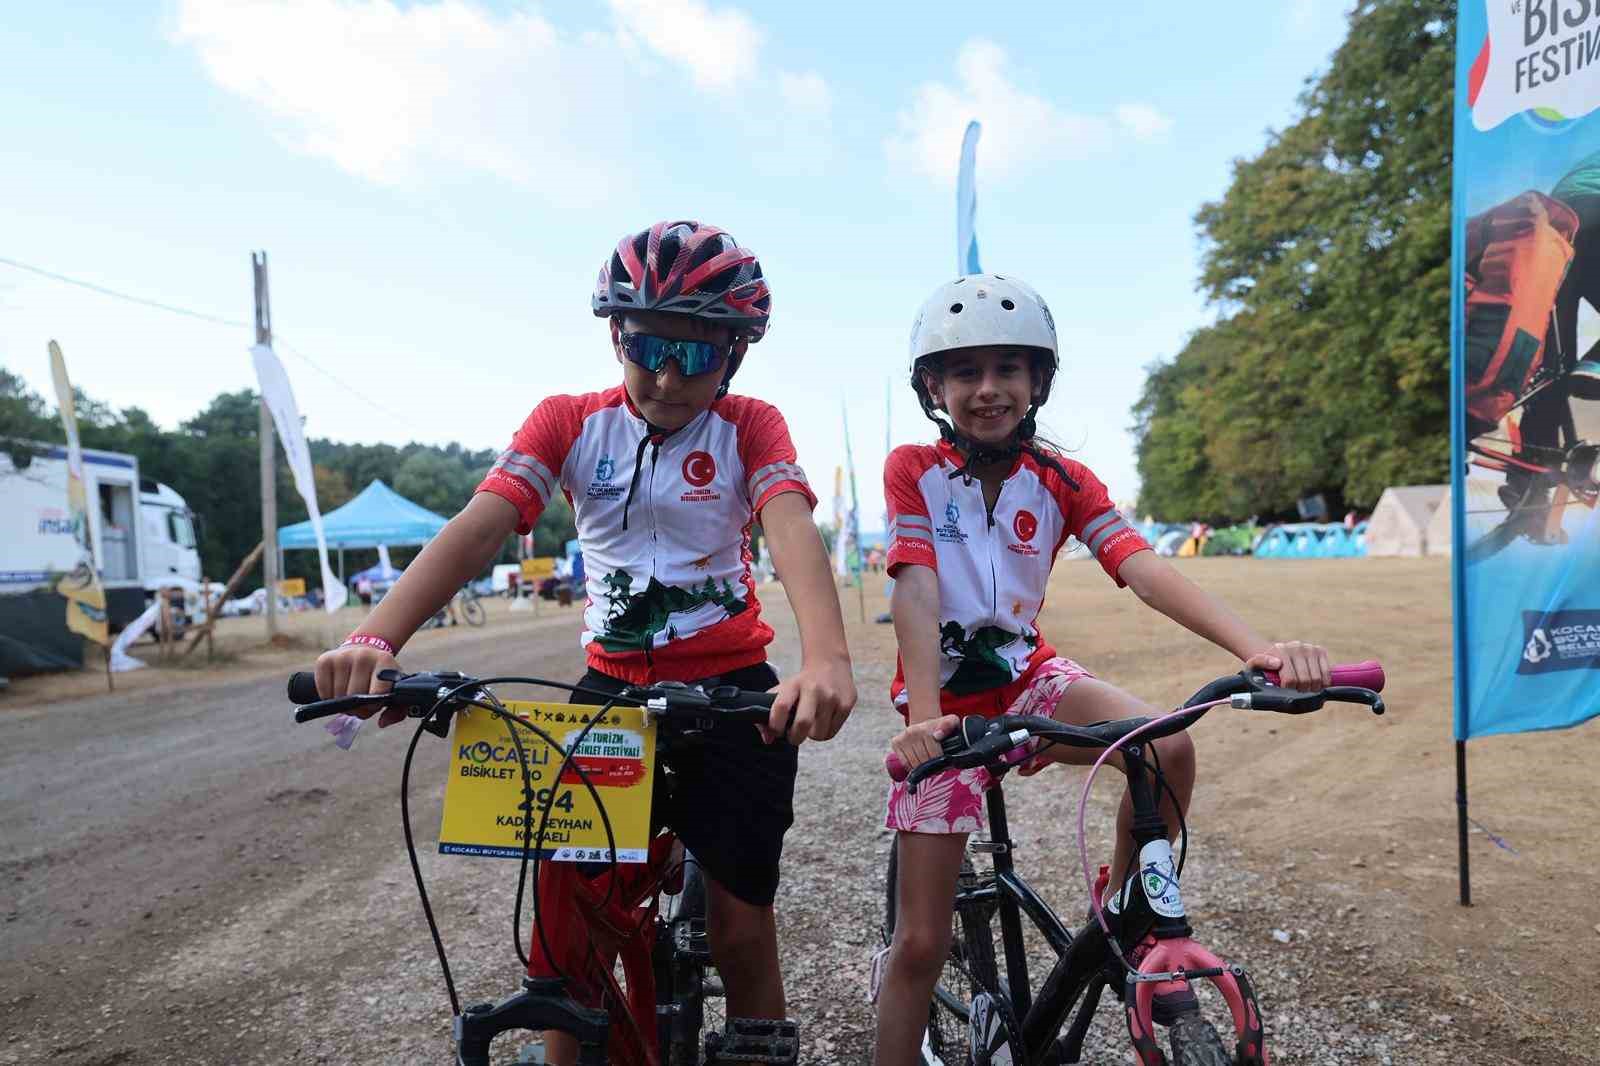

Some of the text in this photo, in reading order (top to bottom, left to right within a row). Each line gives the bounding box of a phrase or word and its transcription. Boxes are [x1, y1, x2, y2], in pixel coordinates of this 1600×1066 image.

[592, 731, 624, 744] TURİZM
[459, 740, 549, 765] KOCAELİ
[566, 743, 641, 757] BSİKLET FESTİVALİ
[461, 764, 516, 779] BİSİKLET
[517, 788, 574, 813] 294
